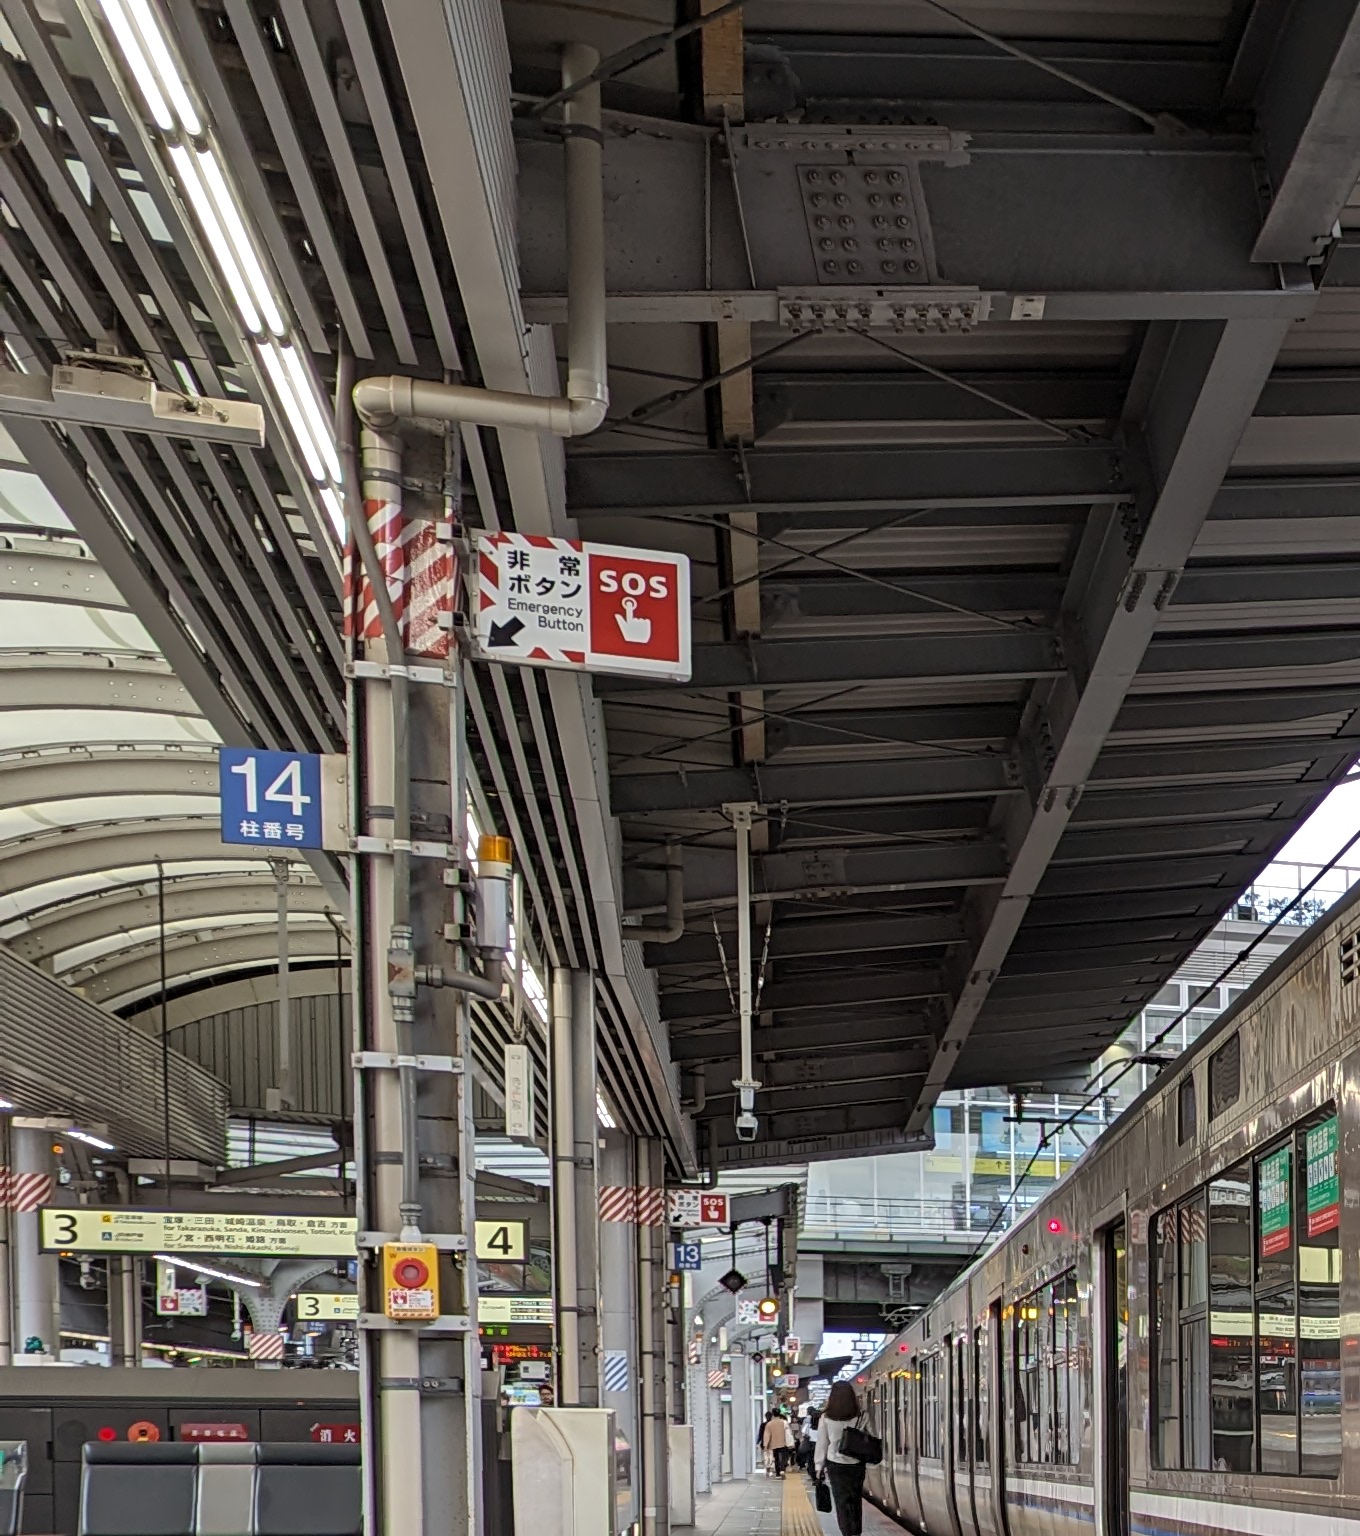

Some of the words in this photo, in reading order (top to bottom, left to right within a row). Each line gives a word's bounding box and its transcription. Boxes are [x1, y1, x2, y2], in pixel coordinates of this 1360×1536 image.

[507, 550, 581, 577] 非常
[508, 574, 582, 599] ボタン
[599, 569, 668, 599] SOS
[507, 598, 583, 619] Emergency
[538, 615, 584, 633] Button
[231, 757, 311, 816] 14
[240, 820, 304, 841] 柱番号
[703, 1197, 724, 1206] SOS
[54, 1214, 78, 1244] 3
[487, 1226, 513, 1256] 4
[677, 1245, 699, 1263] 13
[305, 1297, 320, 1316] 3
